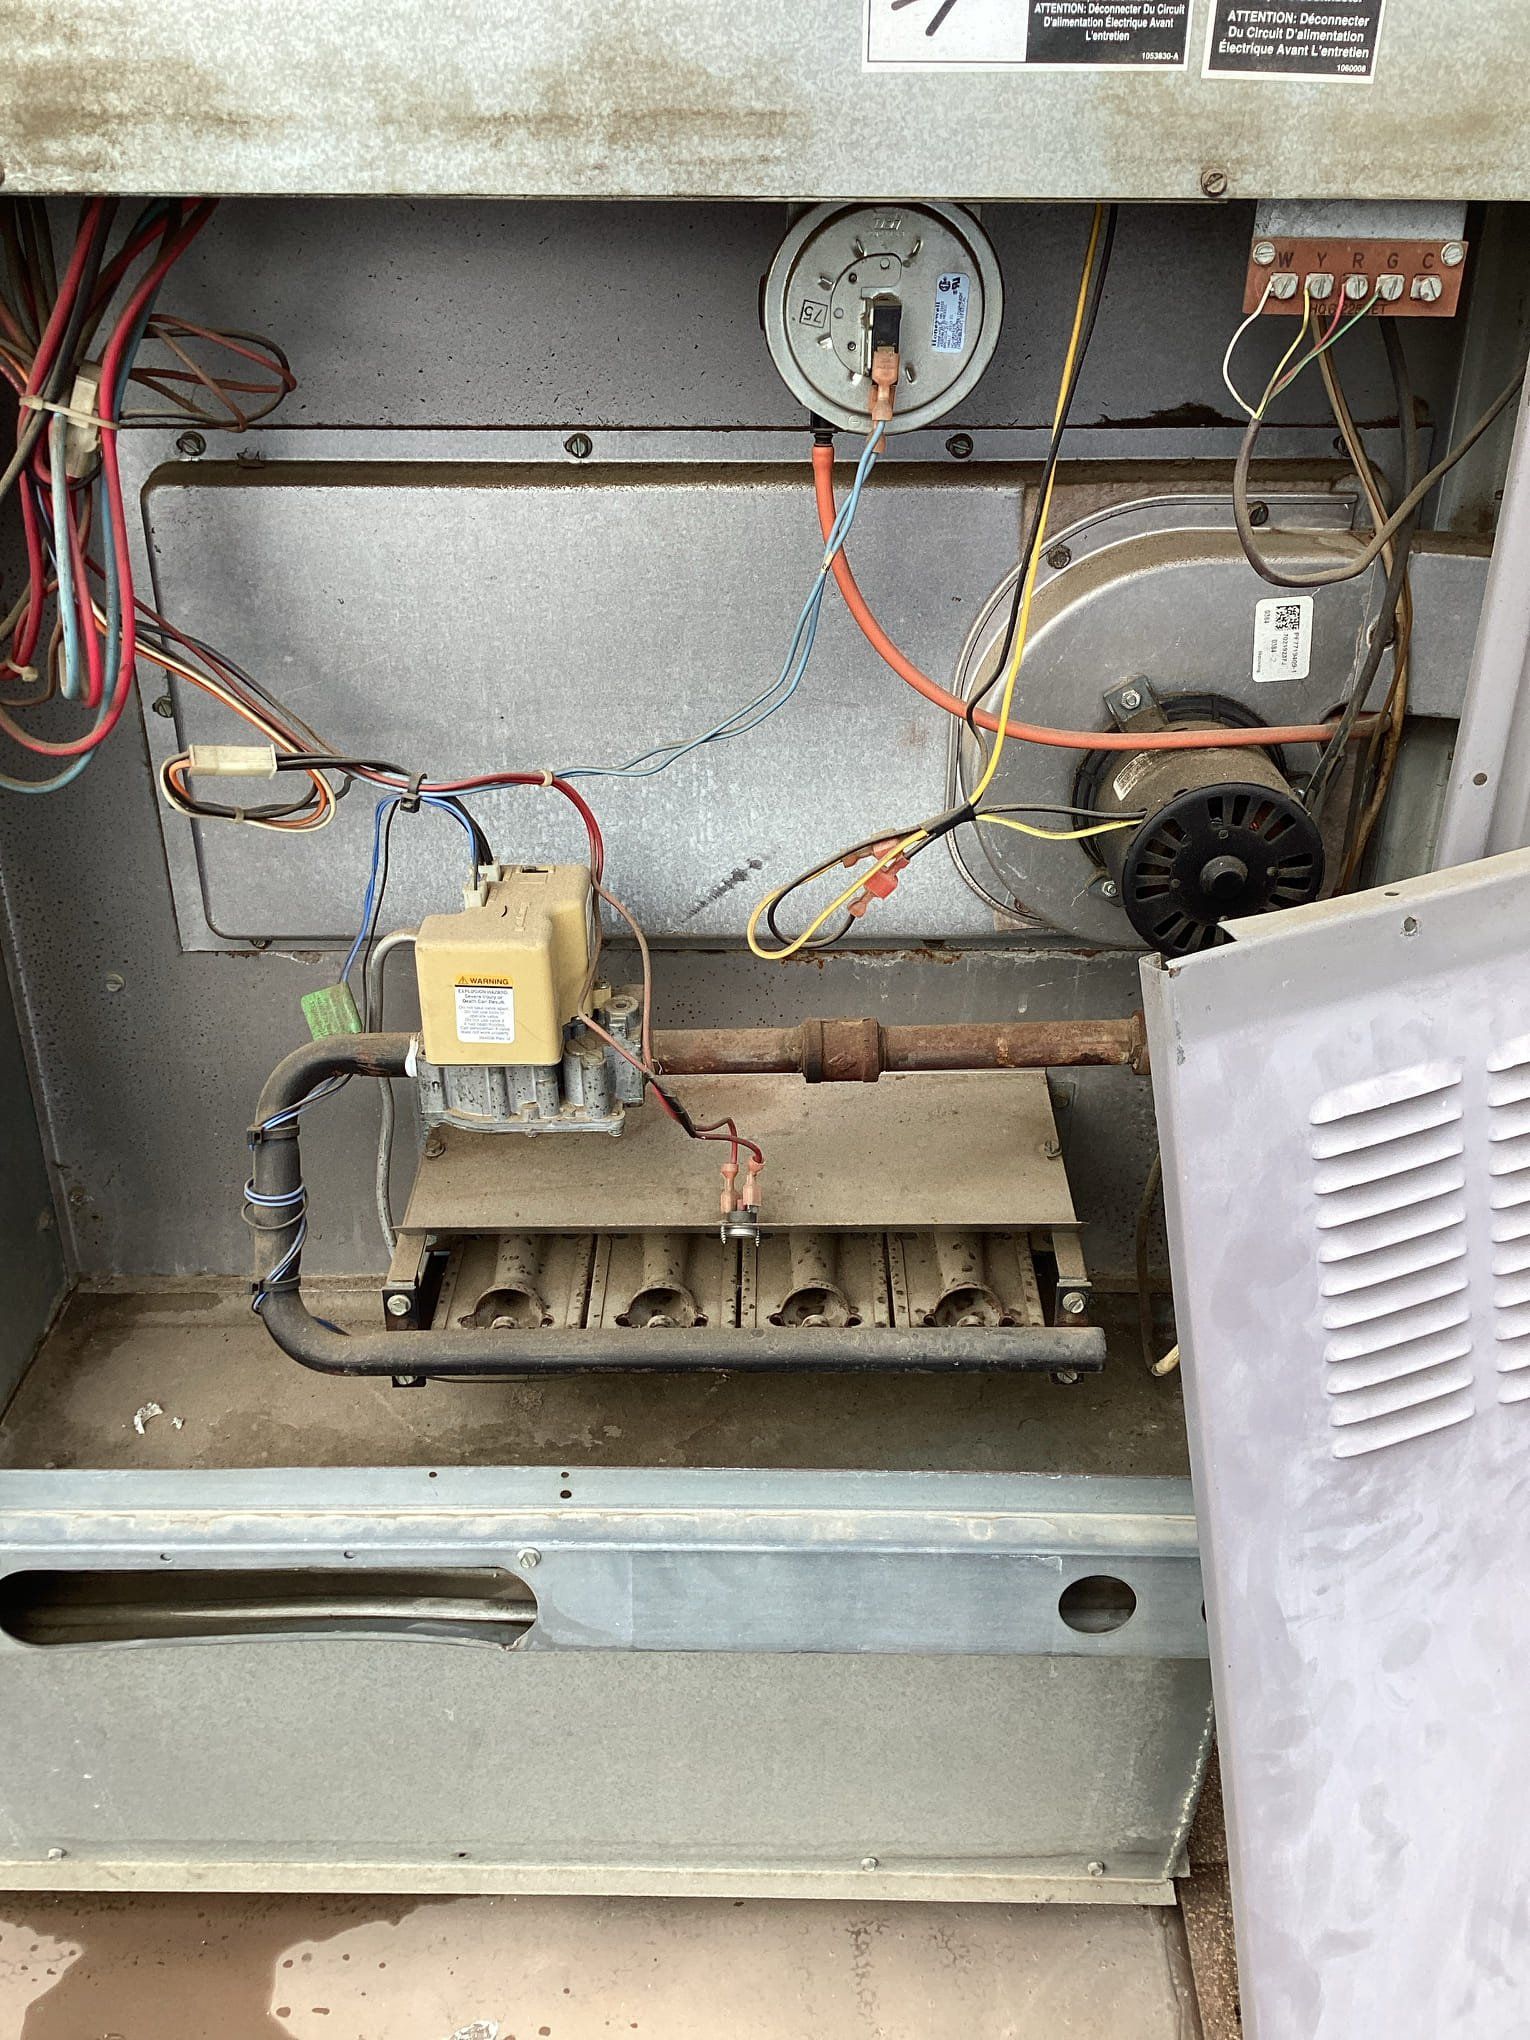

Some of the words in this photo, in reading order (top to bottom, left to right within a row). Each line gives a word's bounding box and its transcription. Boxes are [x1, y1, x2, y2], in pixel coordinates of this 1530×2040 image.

[1034, 3, 1087, 14] ATTENTION:
[1088, 3, 1141, 14] Déconnecter
[1143, 3, 1155, 14] Du
[1157, 4, 1185, 15] Circuit
[1043, 17, 1103, 27] D'alimentation
[1105, 15, 1148, 30] Électrique
[1149, 17, 1174, 28] Avant
[1227, 10, 1297, 24] ATTENTION:
[1299, 12, 1370, 27] Déconnecter
[1086, 31, 1130, 41] L'entretien
[1228, 26, 1244, 38] Du
[1246, 27, 1283, 40] Circuit
[1286, 28, 1364, 43] D'alimentation
[1219, 39, 1274, 57] Électrique
[1276, 44, 1309, 56] Avant
[1311, 45, 1369, 59] L'entretien
[1278, 252, 1295, 268] W
[1317, 252, 1328, 268] Y
[1352, 252, 1365, 268] R
[1387, 252, 1399, 268] G
[1422, 252, 1435, 268] C
[804, 306, 824, 323] 75
